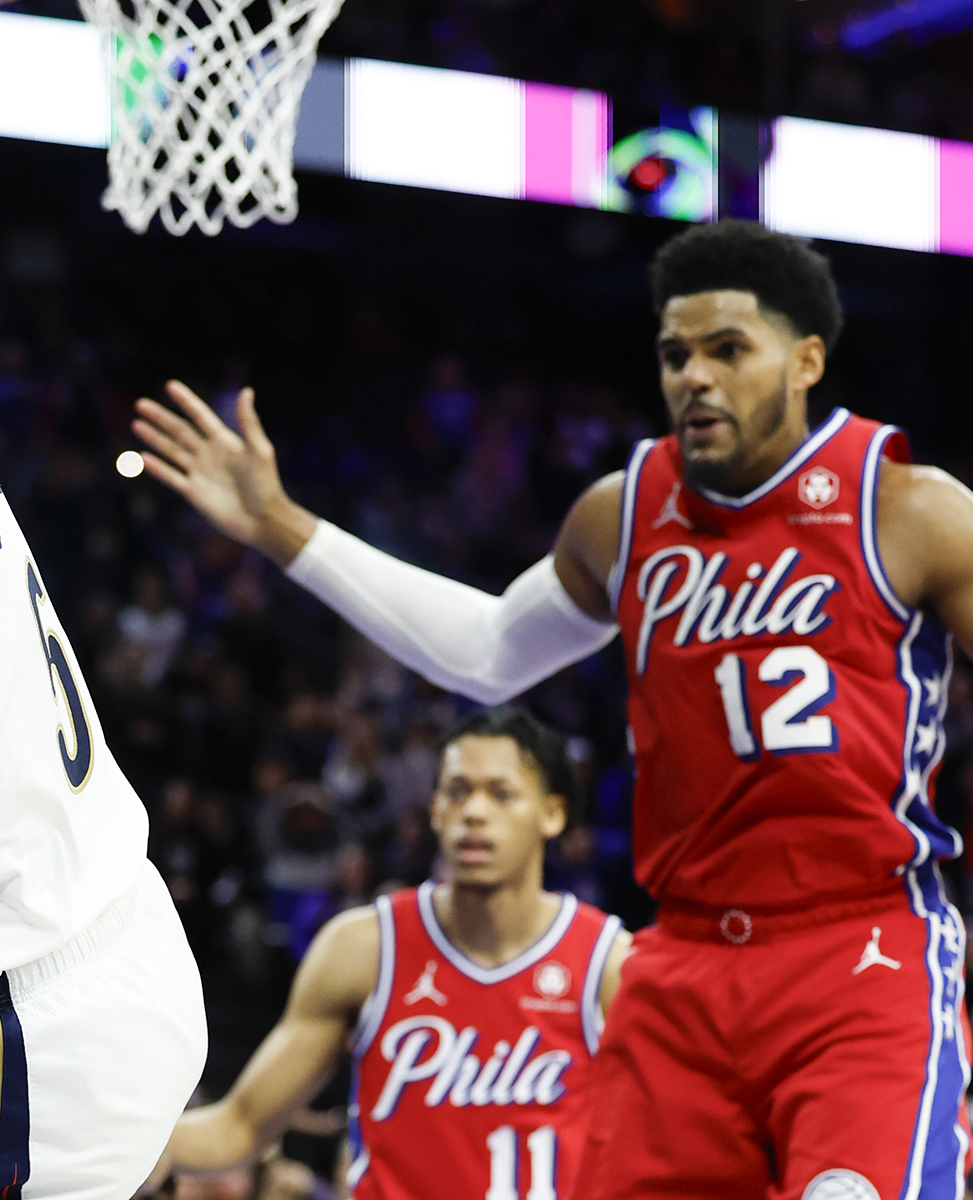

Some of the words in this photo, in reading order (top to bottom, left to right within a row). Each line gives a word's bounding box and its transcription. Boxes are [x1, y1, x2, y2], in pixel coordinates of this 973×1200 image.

[636, 545, 839, 675] Phila
[25, 555, 94, 794] 5
[714, 645, 839, 762] 12
[371, 1014, 573, 1122] Phila
